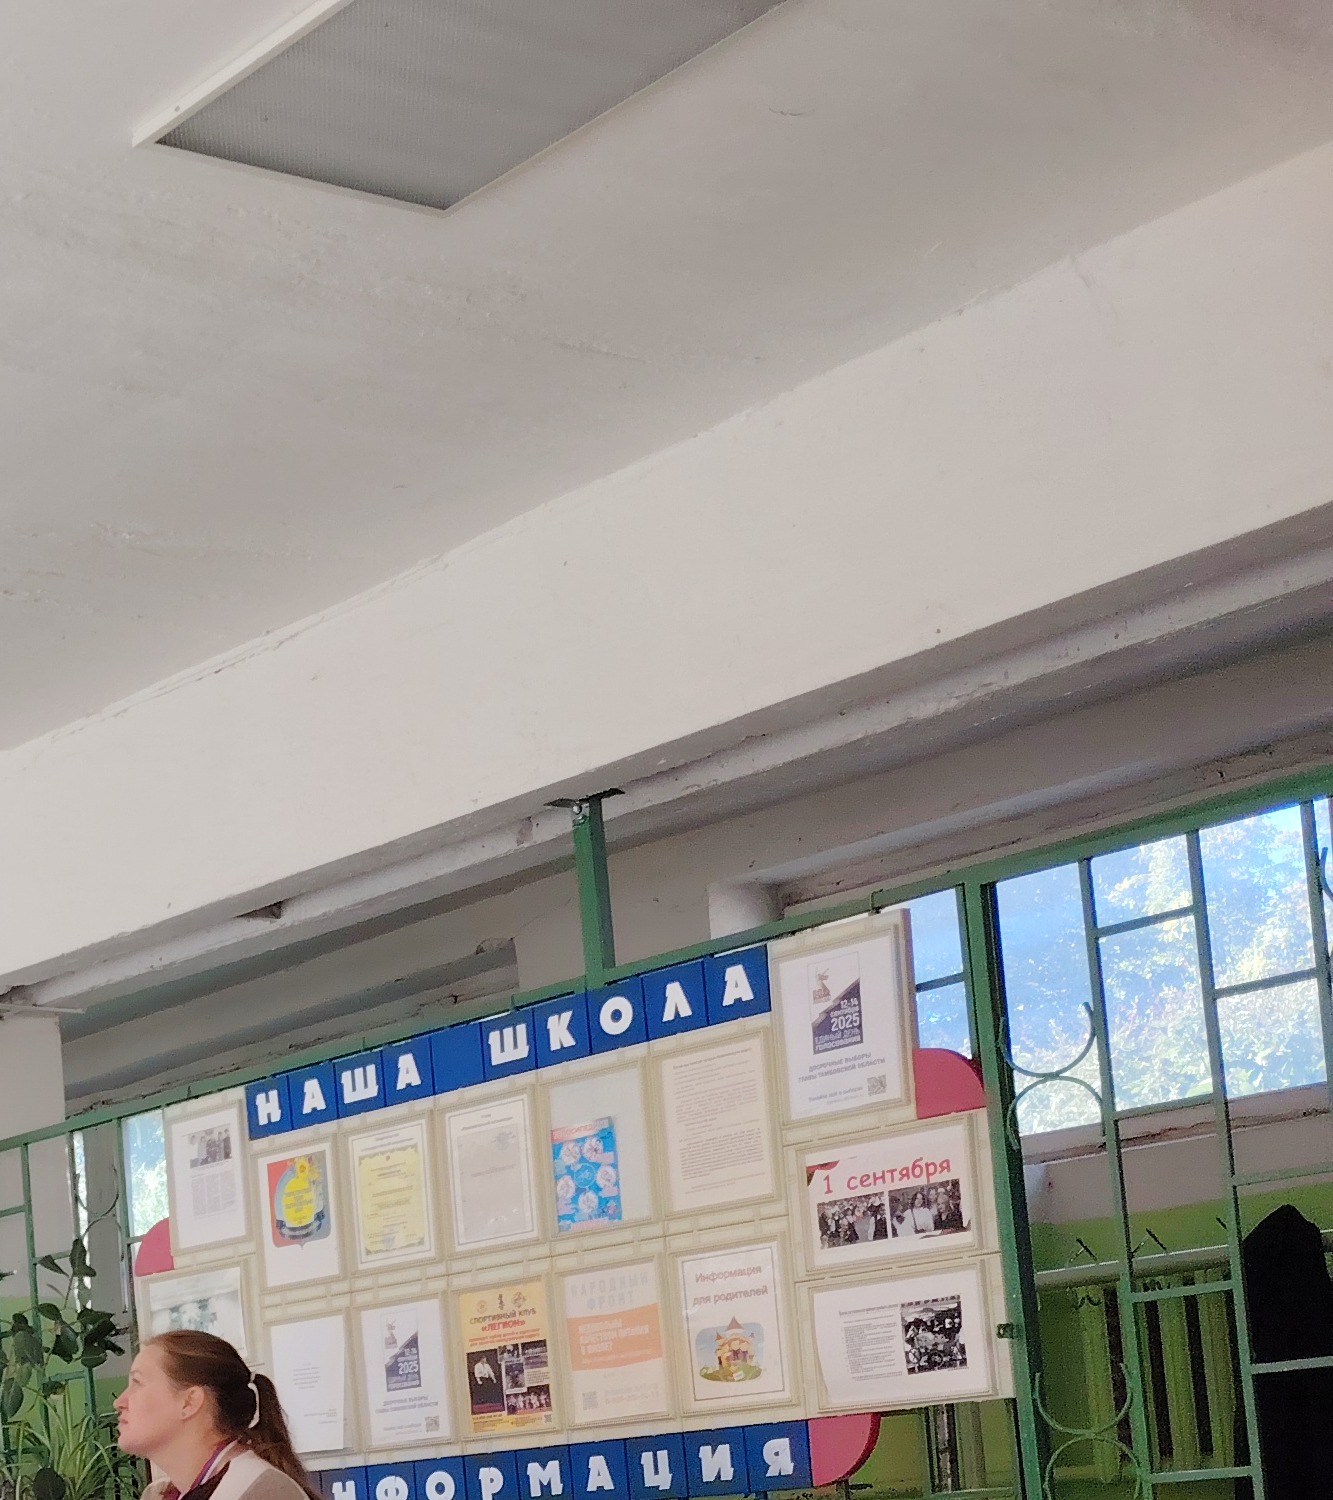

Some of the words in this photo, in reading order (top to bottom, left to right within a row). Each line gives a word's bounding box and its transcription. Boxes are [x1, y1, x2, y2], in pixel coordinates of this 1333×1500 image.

[831, 1013, 860, 1032] 2025
[256, 1053, 421, 1125] НАША
[488, 964, 754, 1066] ШКОЛА
[823, 1174, 834, 1195] 1
[846, 1157, 952, 1191] сентября
[695, 1265, 762, 1283] Информация
[693, 1296, 712, 1307] для
[714, 1285, 769, 1305] родителей
[469, 1309, 517, 1325] СПОРТИВНЫЙ
[517, 1307, 537, 1318] КЛУБ
[397, 1361, 419, 1375] 2025
